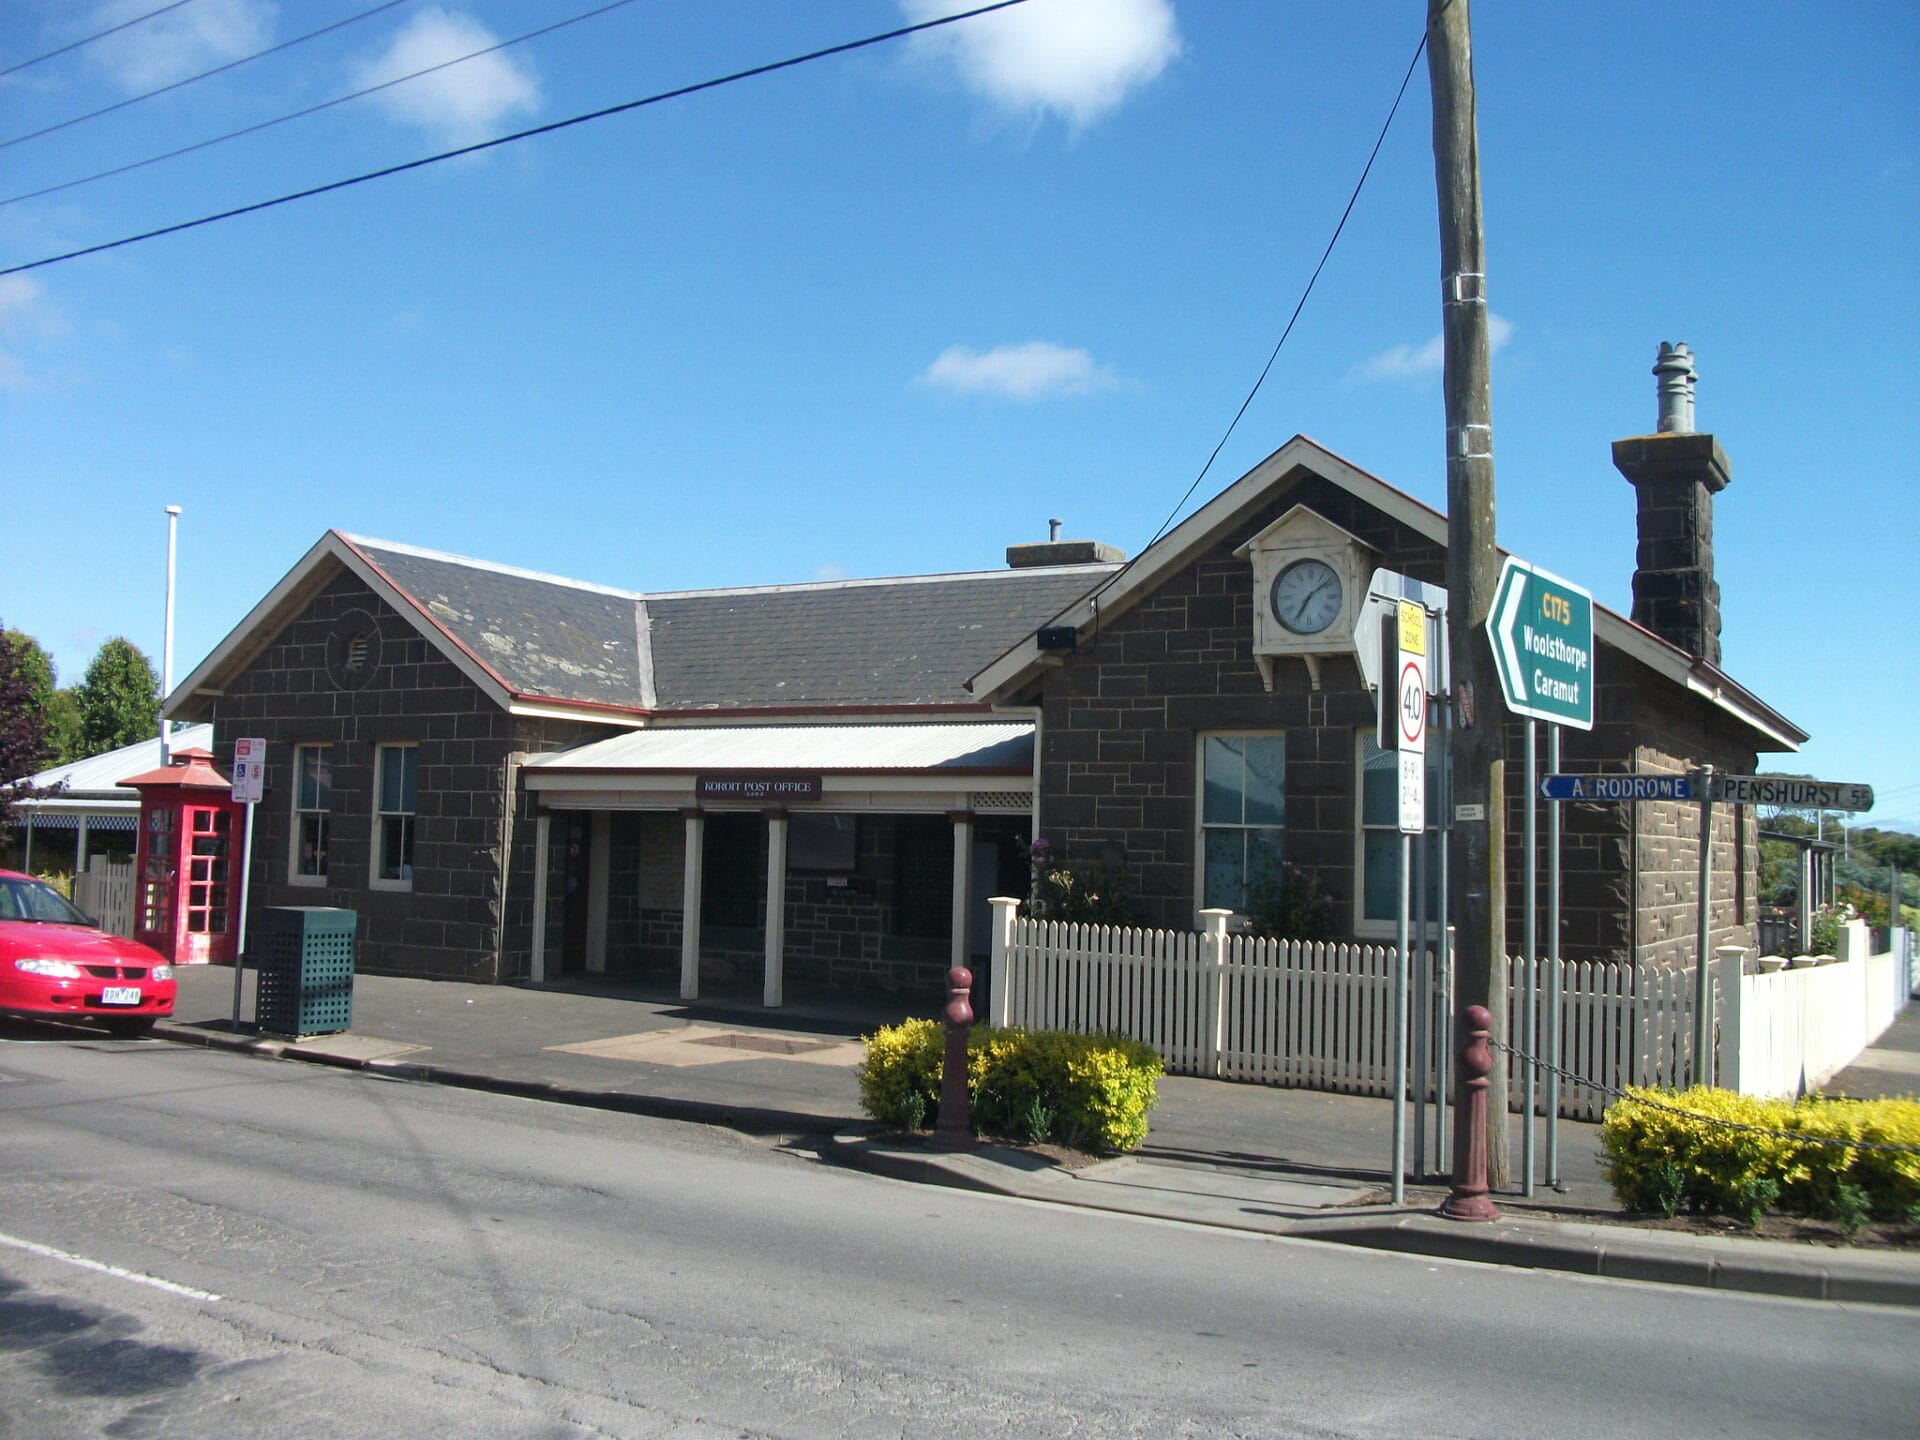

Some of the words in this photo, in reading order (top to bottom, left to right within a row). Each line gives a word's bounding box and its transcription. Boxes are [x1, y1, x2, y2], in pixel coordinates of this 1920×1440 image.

[1401, 610, 1422, 628] SCHOOL
[1542, 592, 1571, 626] C175
[1405, 630, 1419, 646] ZONE
[1523, 624, 1587, 672] Woolsthorpe
[1534, 668, 1579, 705] Caramut
[1403, 684, 1421, 721] 40
[704, 781, 741, 792] KOROIT
[744, 781, 771, 792] POST
[774, 781, 812, 792] OFFICE
[1572, 778, 1686, 798] ARODROME
[1724, 779, 1840, 805] PENSHURST
